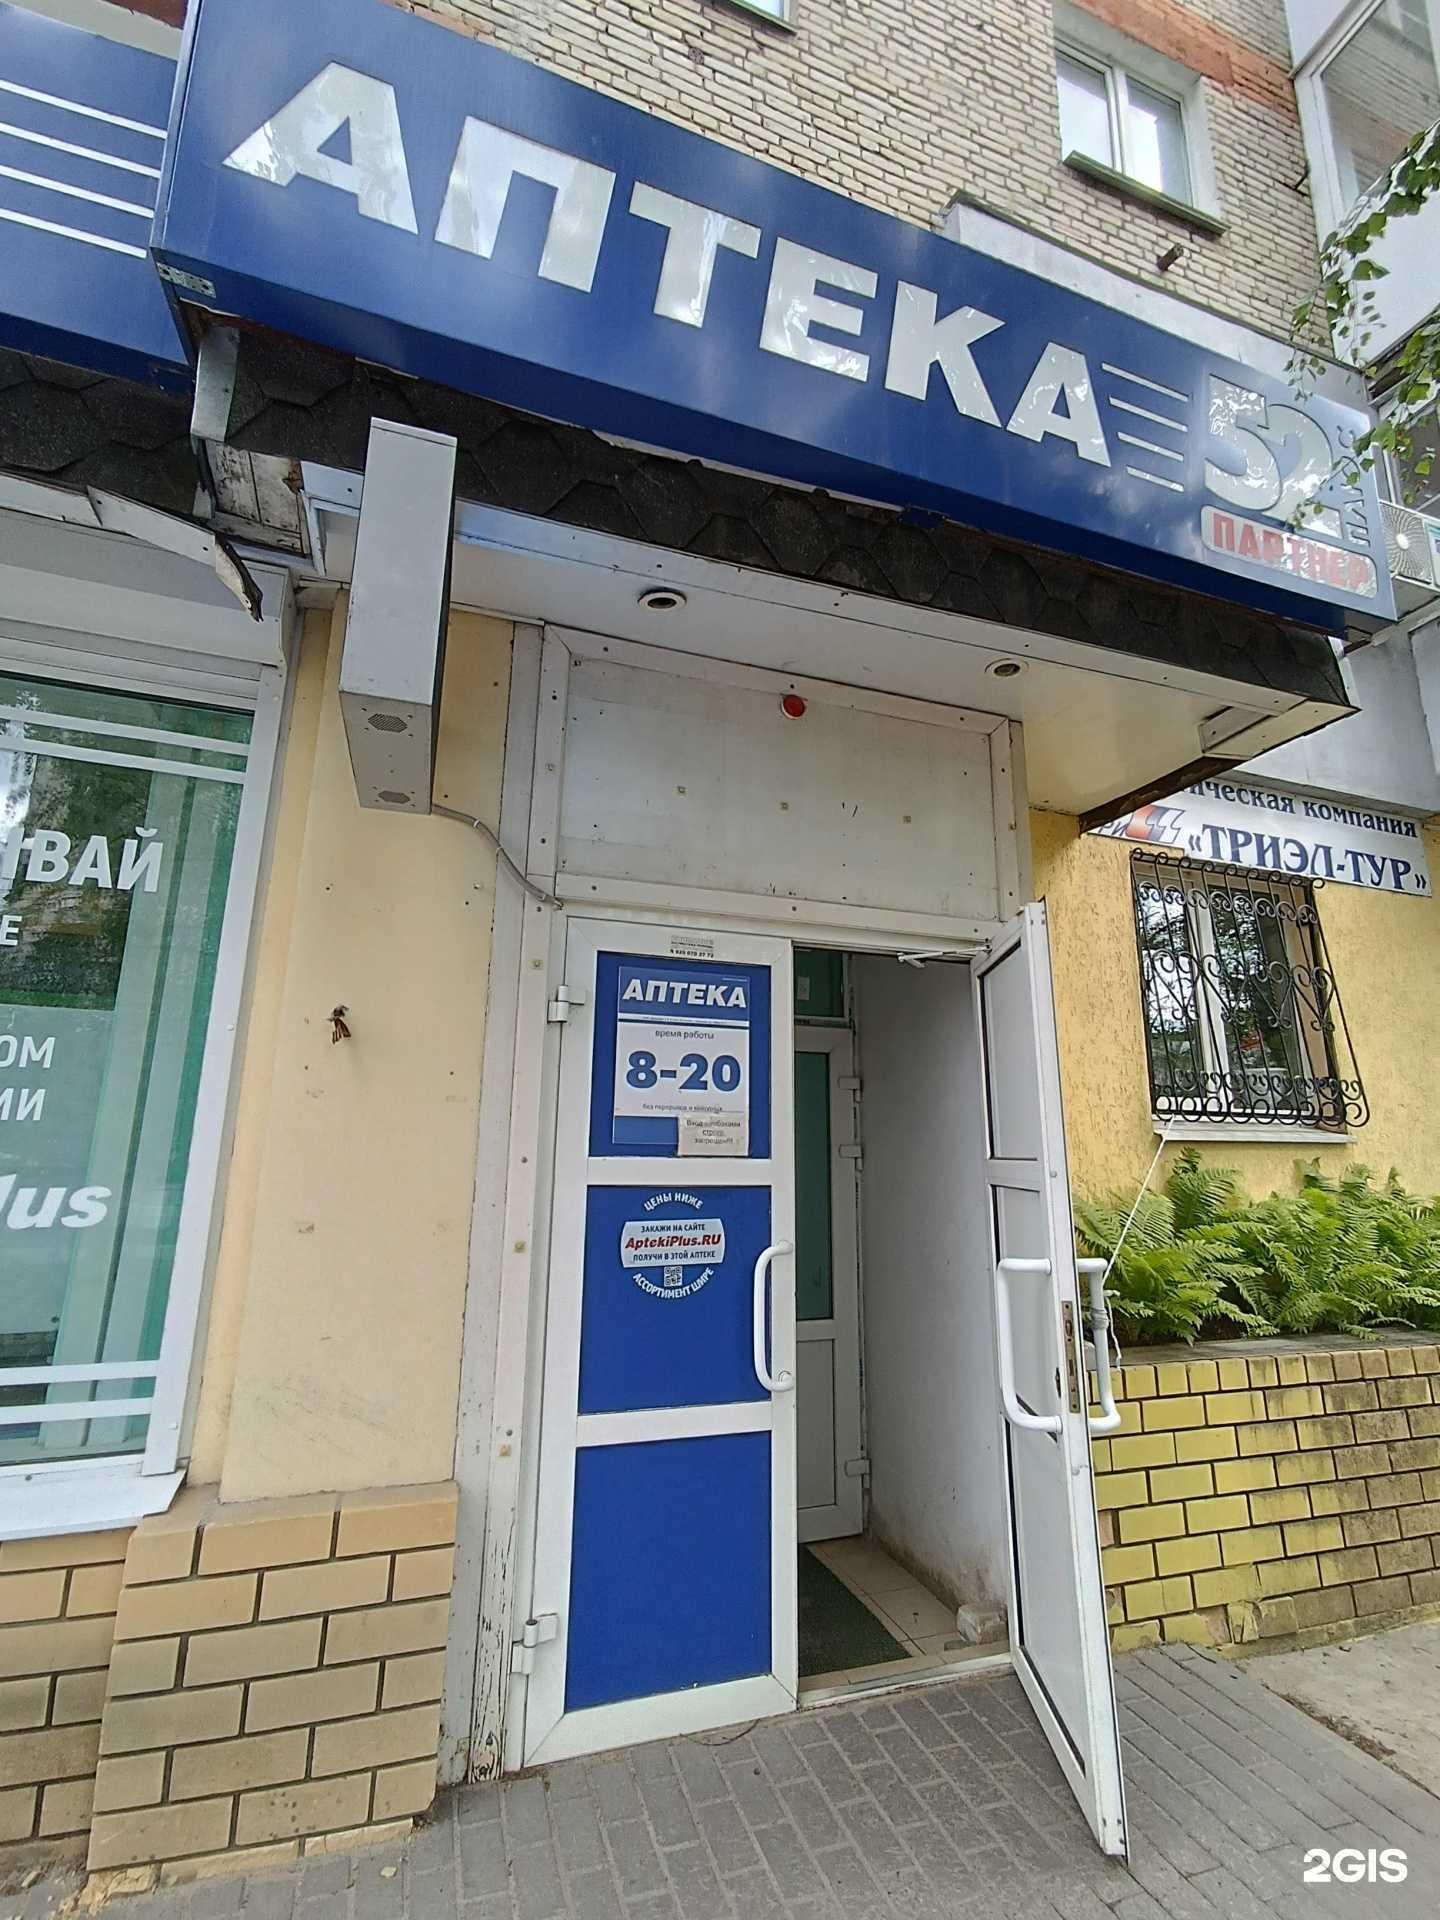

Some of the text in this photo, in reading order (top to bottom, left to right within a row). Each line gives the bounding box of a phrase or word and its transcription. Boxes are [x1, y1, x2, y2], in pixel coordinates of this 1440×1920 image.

[222, 60, 1111, 467] АПТЕКА
[1204, 373, 1344, 540] 52
[1212, 512, 1371, 590] ПАРТНЕР
[1188, 779, 1418, 838] ическая компания
[1187, 823, 1427, 890] «ТРИЭЛ-ТУР»
[622, 978, 747, 1009] АПТЕКА
[655, 1030, 714, 1040] время работы
[626, 1050, 741, 1092] 8-20
[643, 1191, 704, 1212] ЦЕНЫ НИЖЕ
[625, 1233, 722, 1251] AptekiPlus.RU
[641, 1223, 705, 1233] ЗАКАЖИ НА САЙТЕ
[633, 1253, 663, 1262] ПОЛУЧИ
[670, 1250, 688, 1260] ЭТОЙ
[689, 1250, 716, 1259] АПТЕКЕ
[632, 1267, 715, 1299] АССОРТИМЕНТ ШИРЕ
